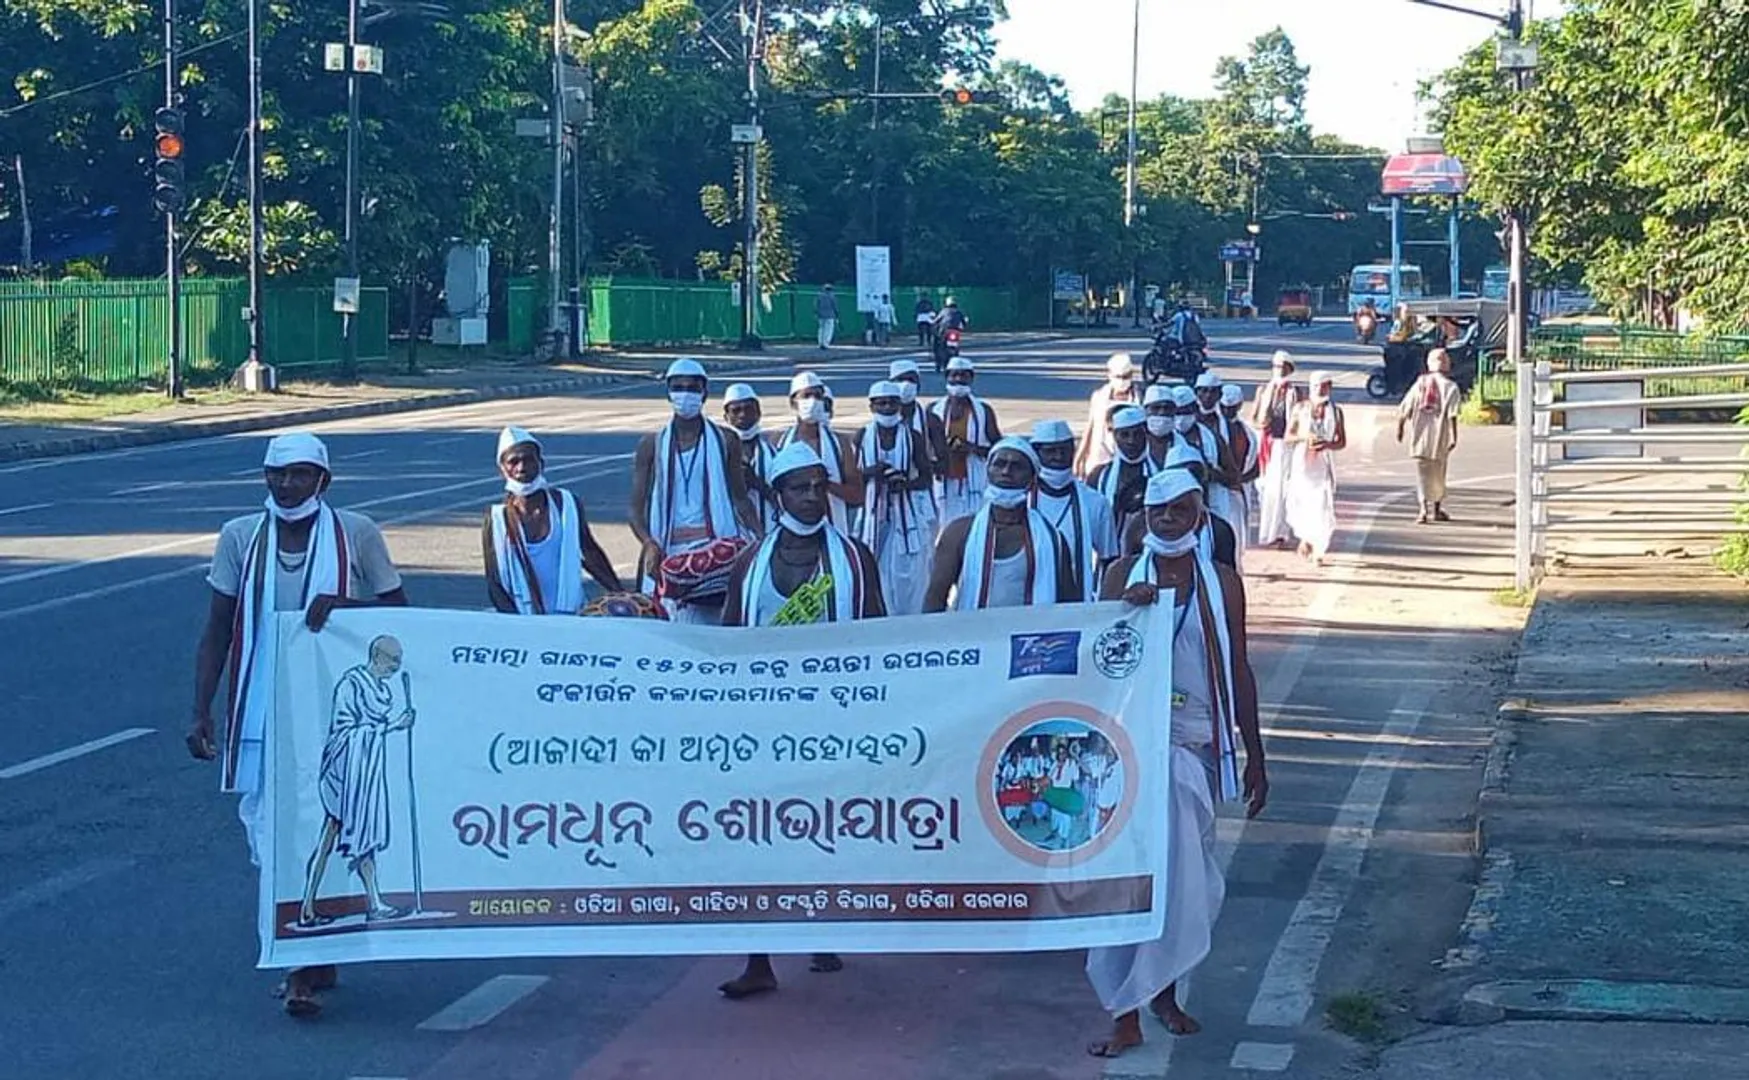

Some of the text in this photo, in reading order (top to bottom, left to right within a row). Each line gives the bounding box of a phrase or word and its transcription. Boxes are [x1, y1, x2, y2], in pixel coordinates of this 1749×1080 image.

[451, 645, 529, 668] ମହାତ୍ମା
[540, 651, 622, 669] ଗାନ୍ଧୀଙ୍କ
[636, 657, 737, 676] ୧୫୨ତମ
[749, 659, 789, 679] ଜନ୍ମ
[801, 655, 871, 675] ଜୟନ୍ତୀ
[648, 684, 819, 703] କଳାକାରମାନଙ୍କ
[488, 726, 928, 774] (ଆଜାଦୀ କା ଅମୃତ ମହୋତ୍ସବ)
[452, 795, 962, 868] ରାମଧୂନ୍ ଶୋଭାଯାତ୍ରା
[630, 895, 680, 915] ଭାଷା,
[689, 891, 749, 912] ସାହିତ୍ୟ
[756, 894, 770, 910] ଓ
[776, 889, 829, 917] ସଂସ୍କୃତି
[836, 889, 897, 913] ବିଭାଗ,
[962, 892, 1029, 909] ସରକାର
